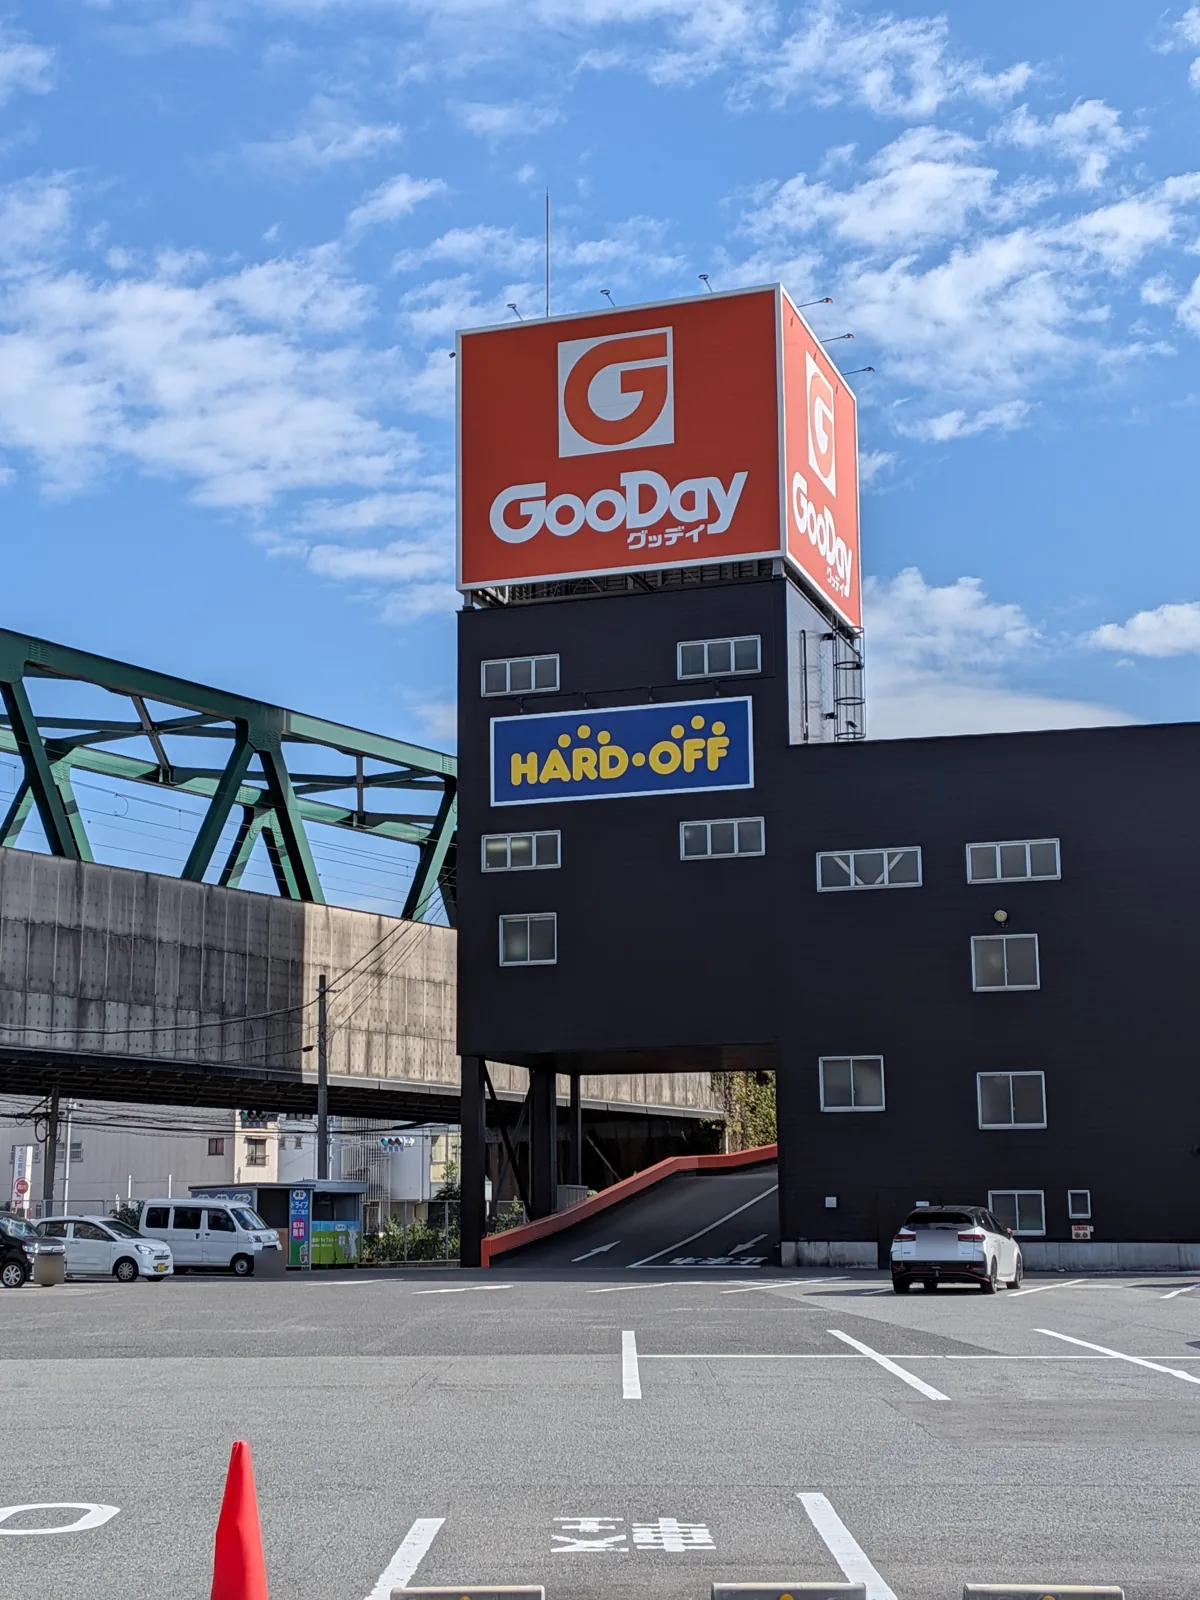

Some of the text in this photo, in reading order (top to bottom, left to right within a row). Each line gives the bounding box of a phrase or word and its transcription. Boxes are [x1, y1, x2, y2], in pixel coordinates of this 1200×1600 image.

[564, 332, 668, 446] G
[489, 470, 749, 544] GooDay
[626, 525, 706, 550] グッデイ
[792, 472, 852, 597] GooDay
